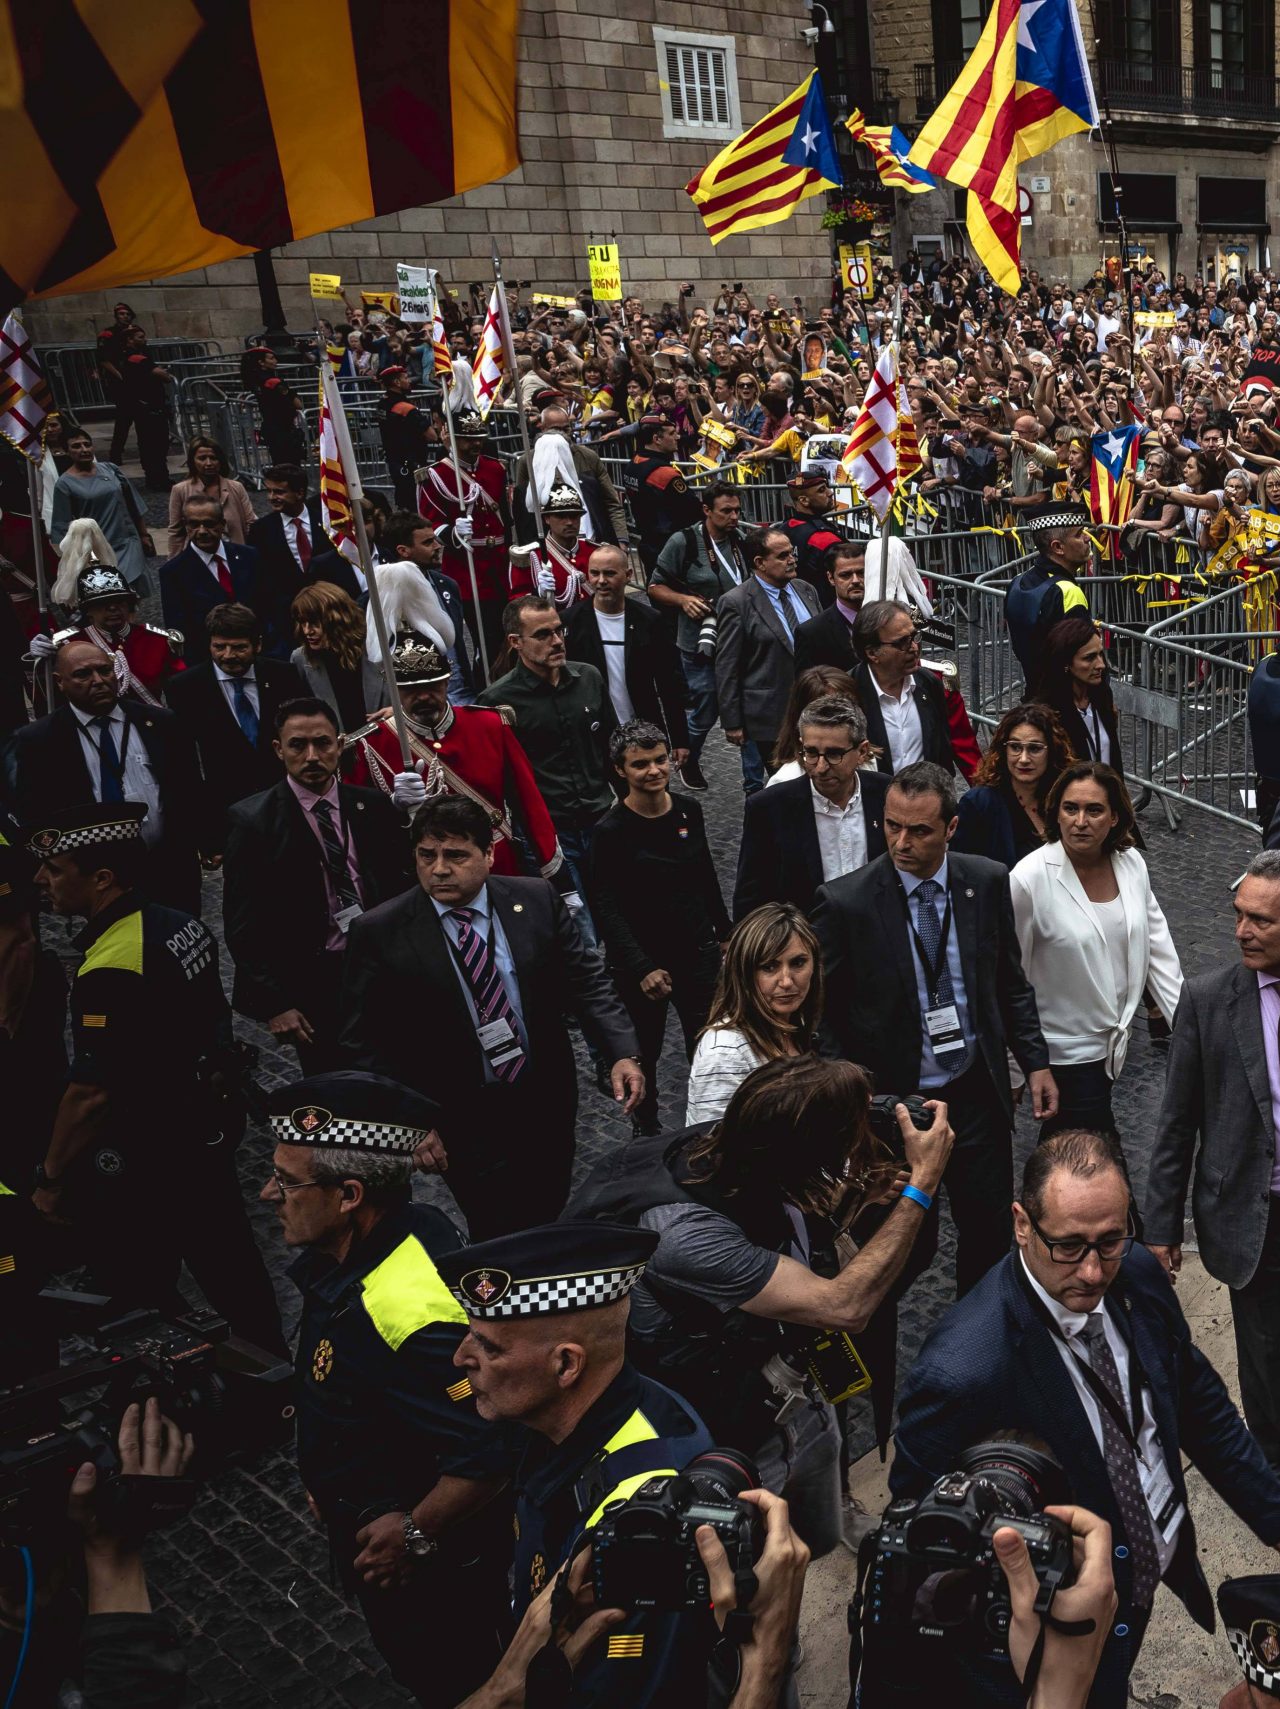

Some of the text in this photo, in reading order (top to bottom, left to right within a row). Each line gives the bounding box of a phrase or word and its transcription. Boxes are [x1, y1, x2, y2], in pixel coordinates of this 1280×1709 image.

[1265, 521, 1280, 534] SO
[935, 629, 953, 640] Barcelona
[918, 1626, 944, 1636] Canon
